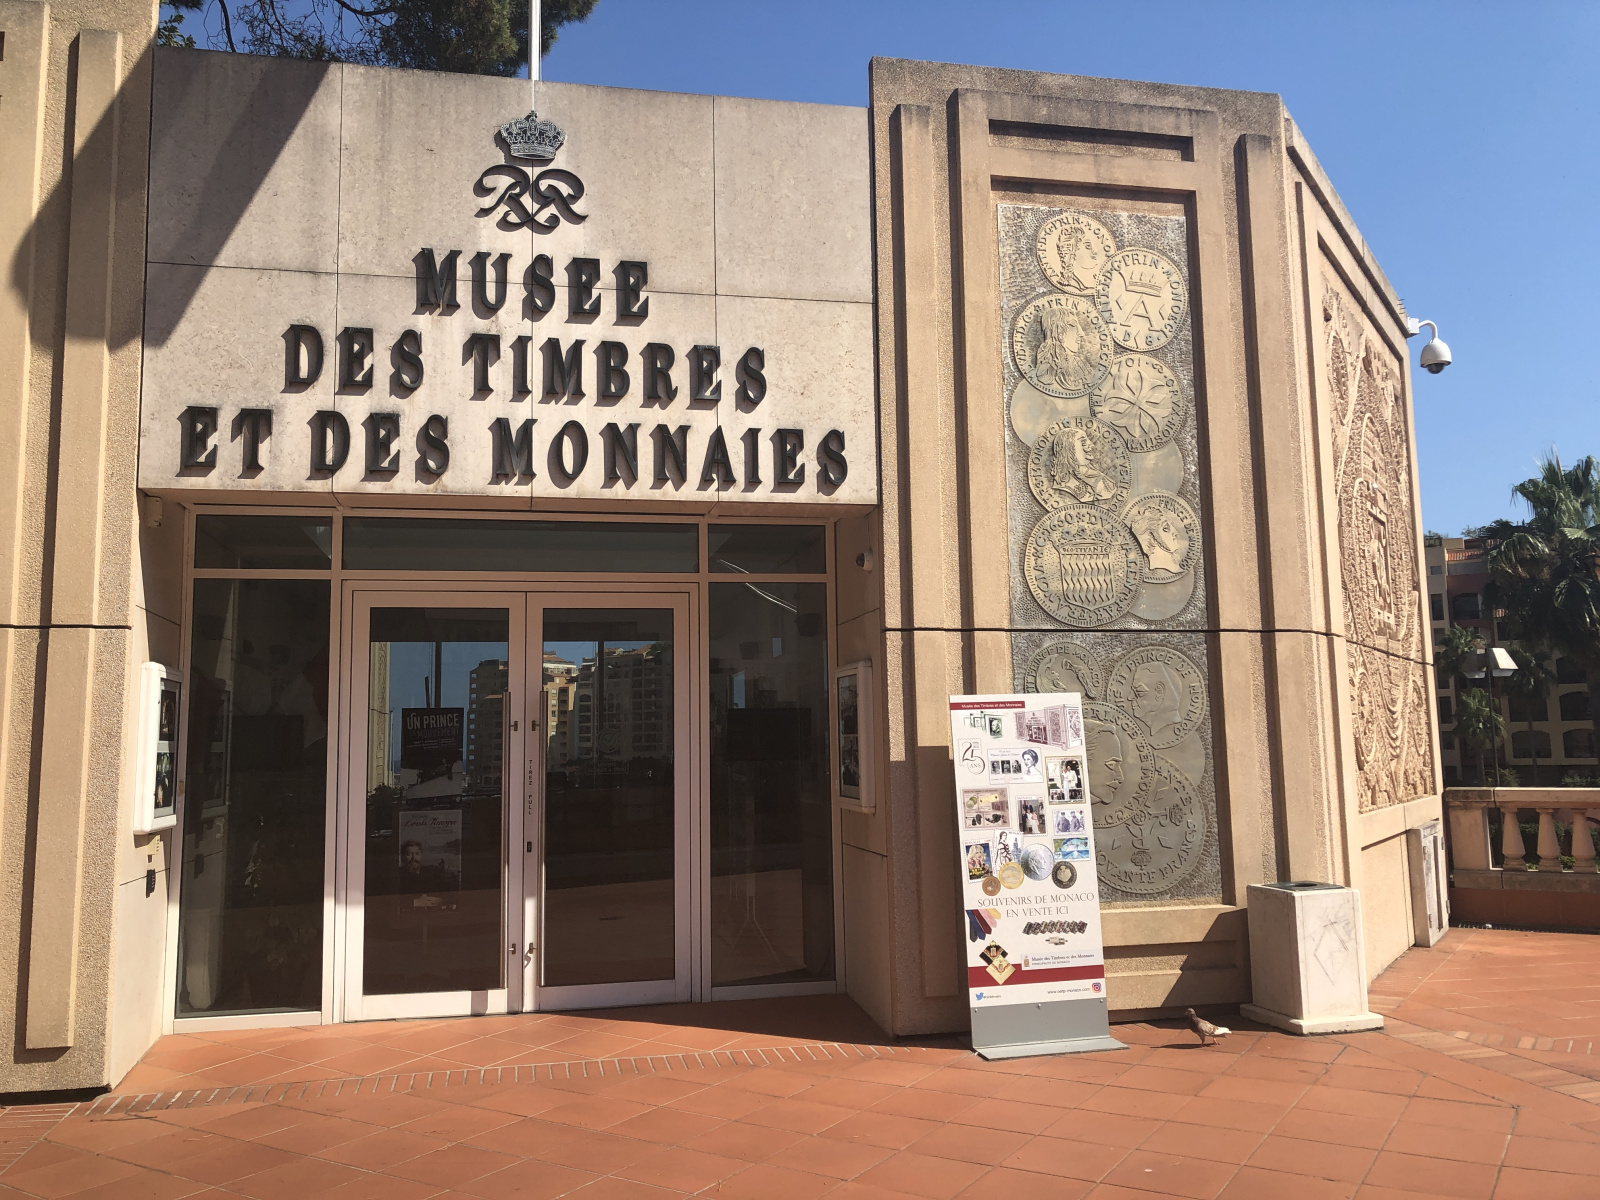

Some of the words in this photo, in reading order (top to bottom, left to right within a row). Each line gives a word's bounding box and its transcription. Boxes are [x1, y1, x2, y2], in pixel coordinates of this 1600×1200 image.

[417, 247, 650, 321] MUSEE
[284, 323, 424, 396] DES
[466, 333, 768, 406] TIMBRES
[181, 404, 273, 477] ET
[312, 408, 450, 480] DES
[494, 416, 849, 488] MONNAIES
[407, 712, 420, 729] UN
[423, 713, 460, 729] PRINCE
[977, 895, 1032, 908] SOUVENIRS
[1035, 894, 1048, 905] DE
[1050, 892, 1095, 903] MONACO
[1006, 909, 1019, 918] EN
[1022, 907, 1053, 917] VENTE
[1056, 905, 1069, 915] ICI
